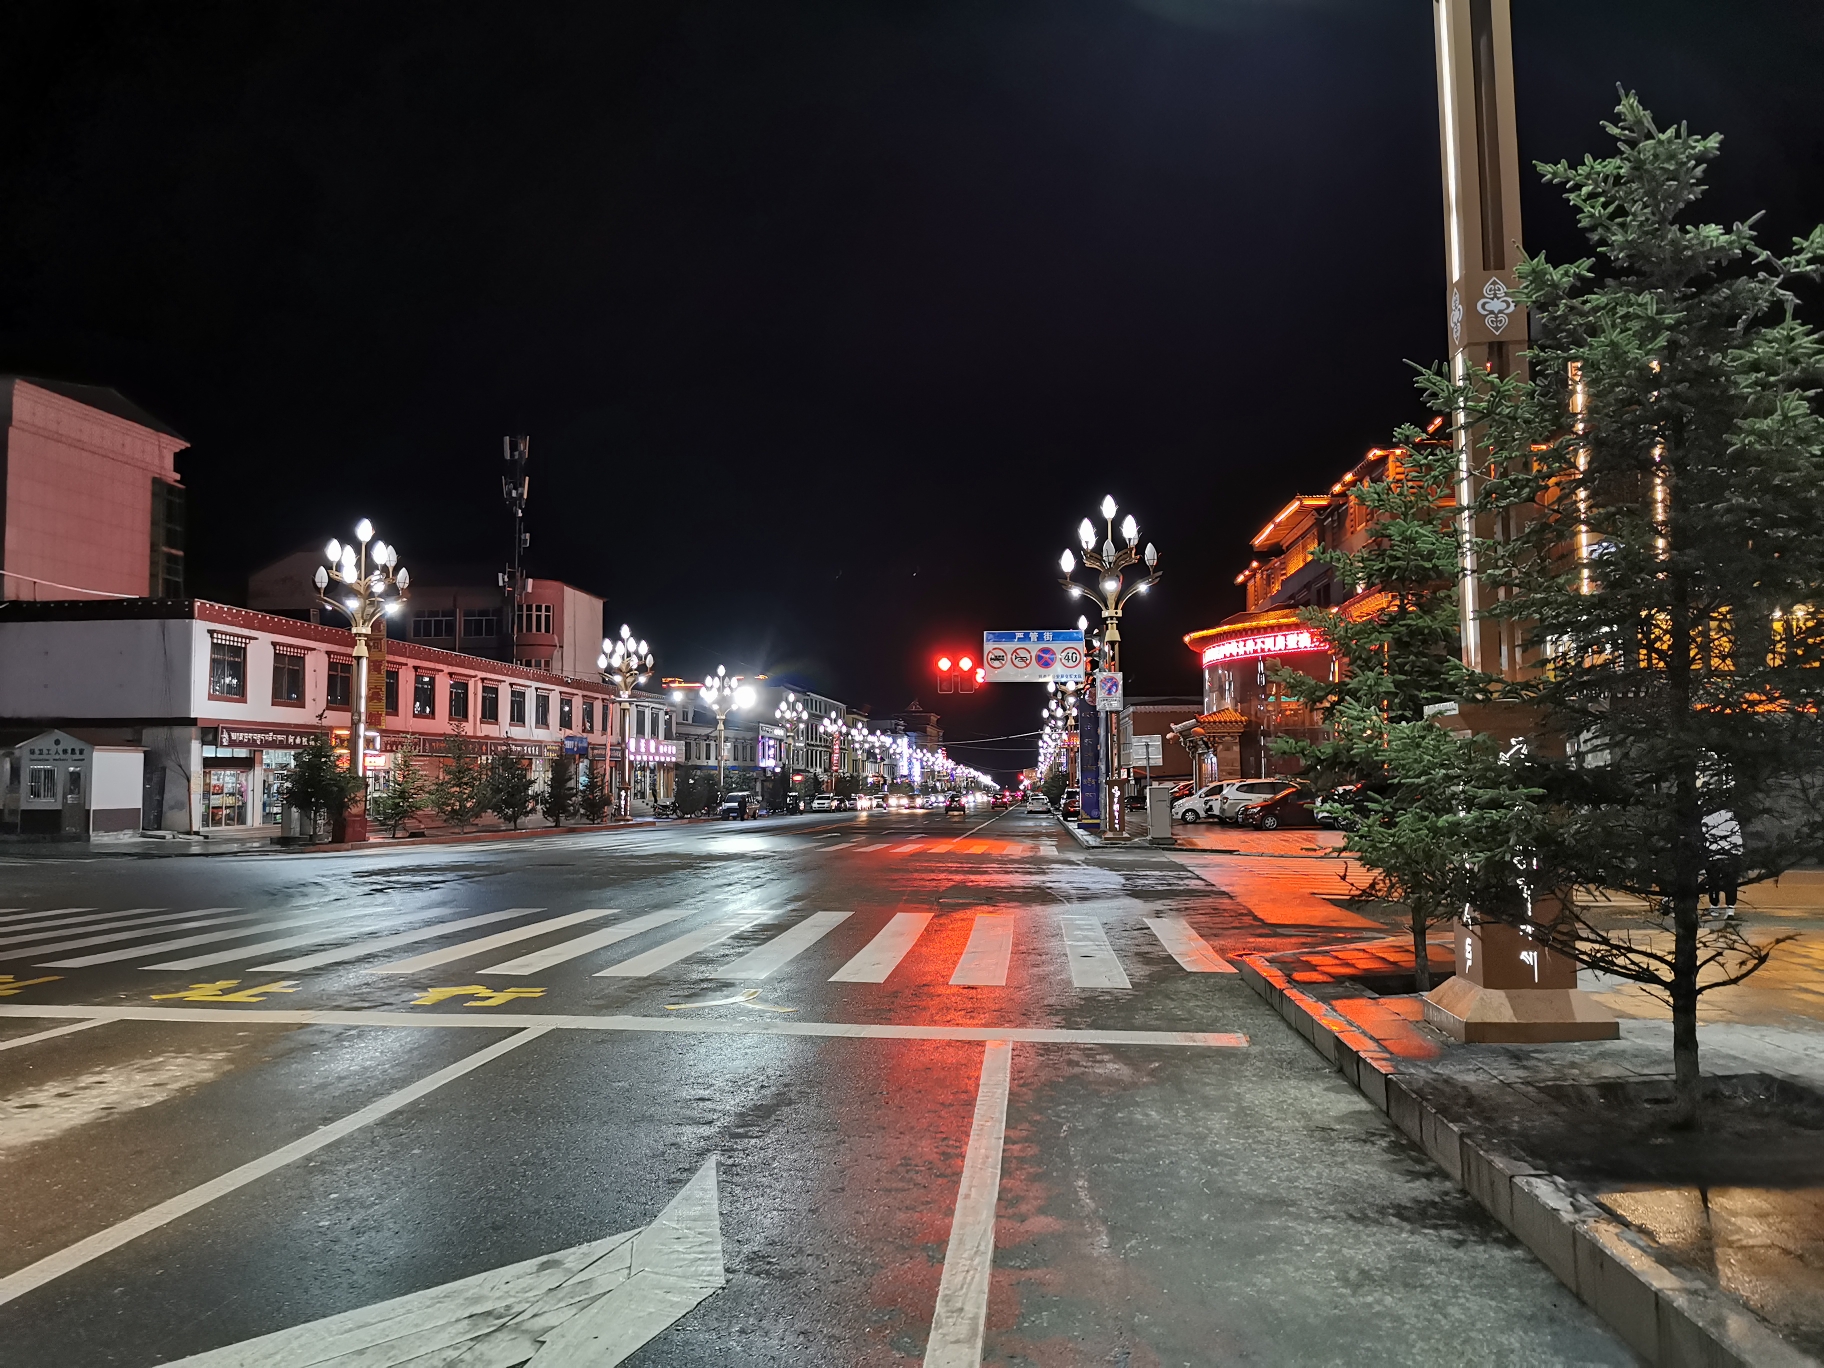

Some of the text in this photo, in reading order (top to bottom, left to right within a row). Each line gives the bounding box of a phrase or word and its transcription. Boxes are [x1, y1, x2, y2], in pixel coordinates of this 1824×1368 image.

[1014, 632, 1053, 642] 严管街
[1063, 651, 1078, 663] 40
